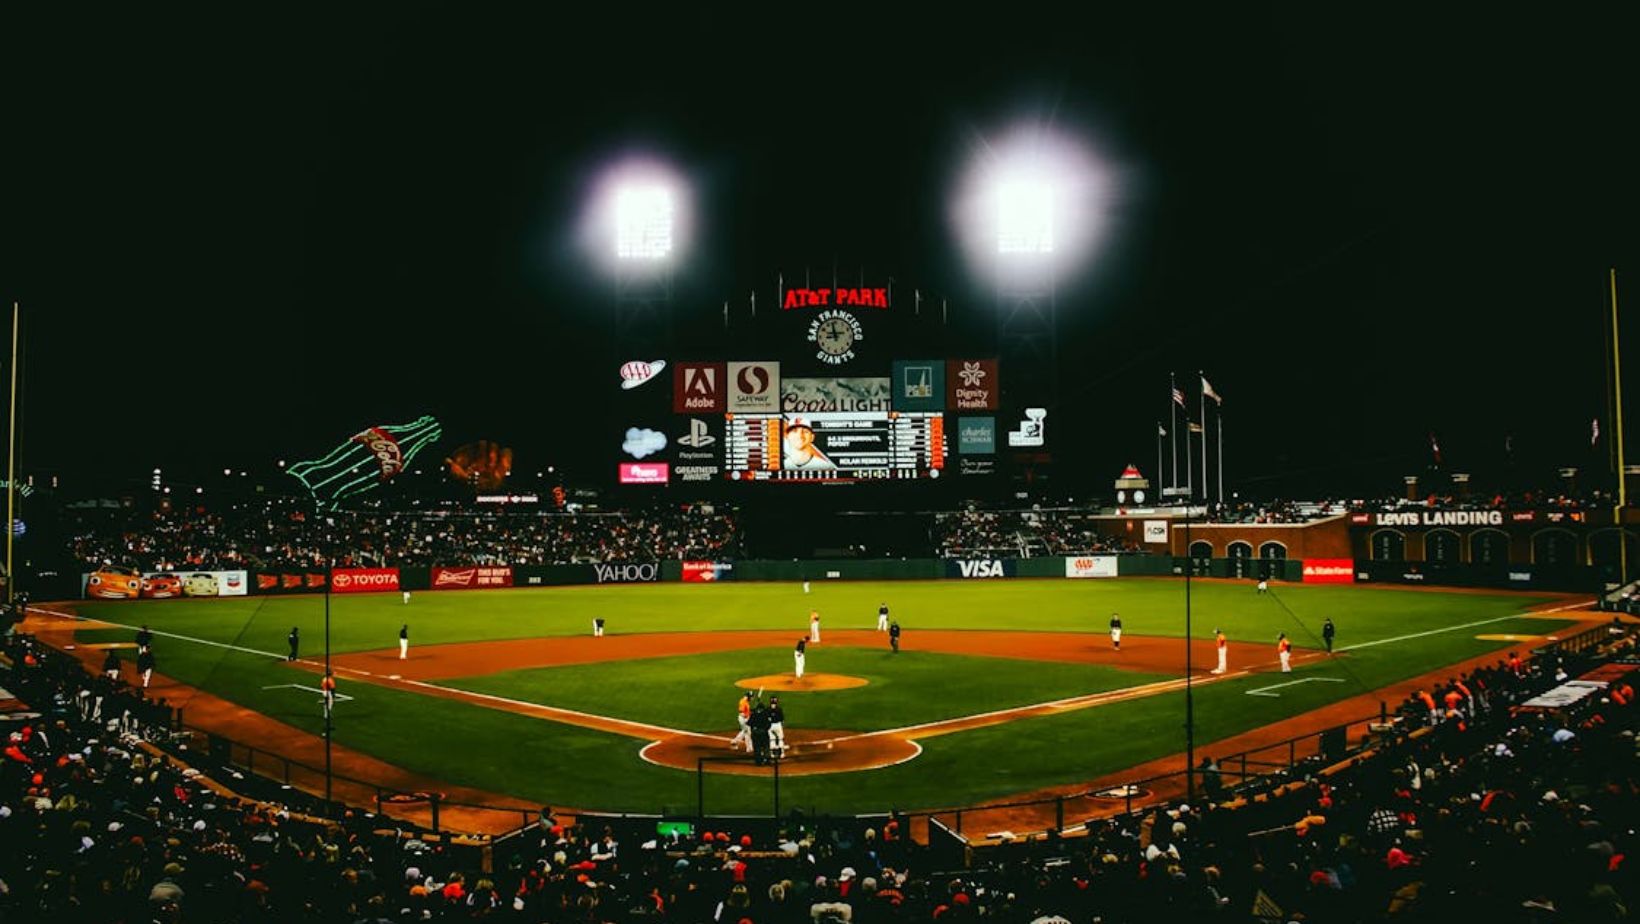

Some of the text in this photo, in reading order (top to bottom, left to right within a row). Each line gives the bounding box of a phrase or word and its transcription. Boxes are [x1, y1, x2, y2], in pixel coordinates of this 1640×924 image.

[783, 287, 889, 310] AT&T PARK
[807, 309, 863, 341] SAN FRANCISCO
[816, 350, 855, 364] GIANTS
[956, 389, 989, 401] Dignity
[685, 398, 715, 409] Adobe
[782, 392, 892, 413] Coors LIGHT
[957, 400, 988, 409] Health
[370, 440, 401, 477] Cola
[679, 452, 714, 460] PlayStation
[675, 466, 718, 475] GREATNESS
[682, 473, 711, 482] AWAITS
[1423, 510, 1503, 526] LANDING
[594, 563, 658, 582] YAHOO!
[956, 560, 1004, 578] VISA
[353, 574, 398, 585] TOYOTA
